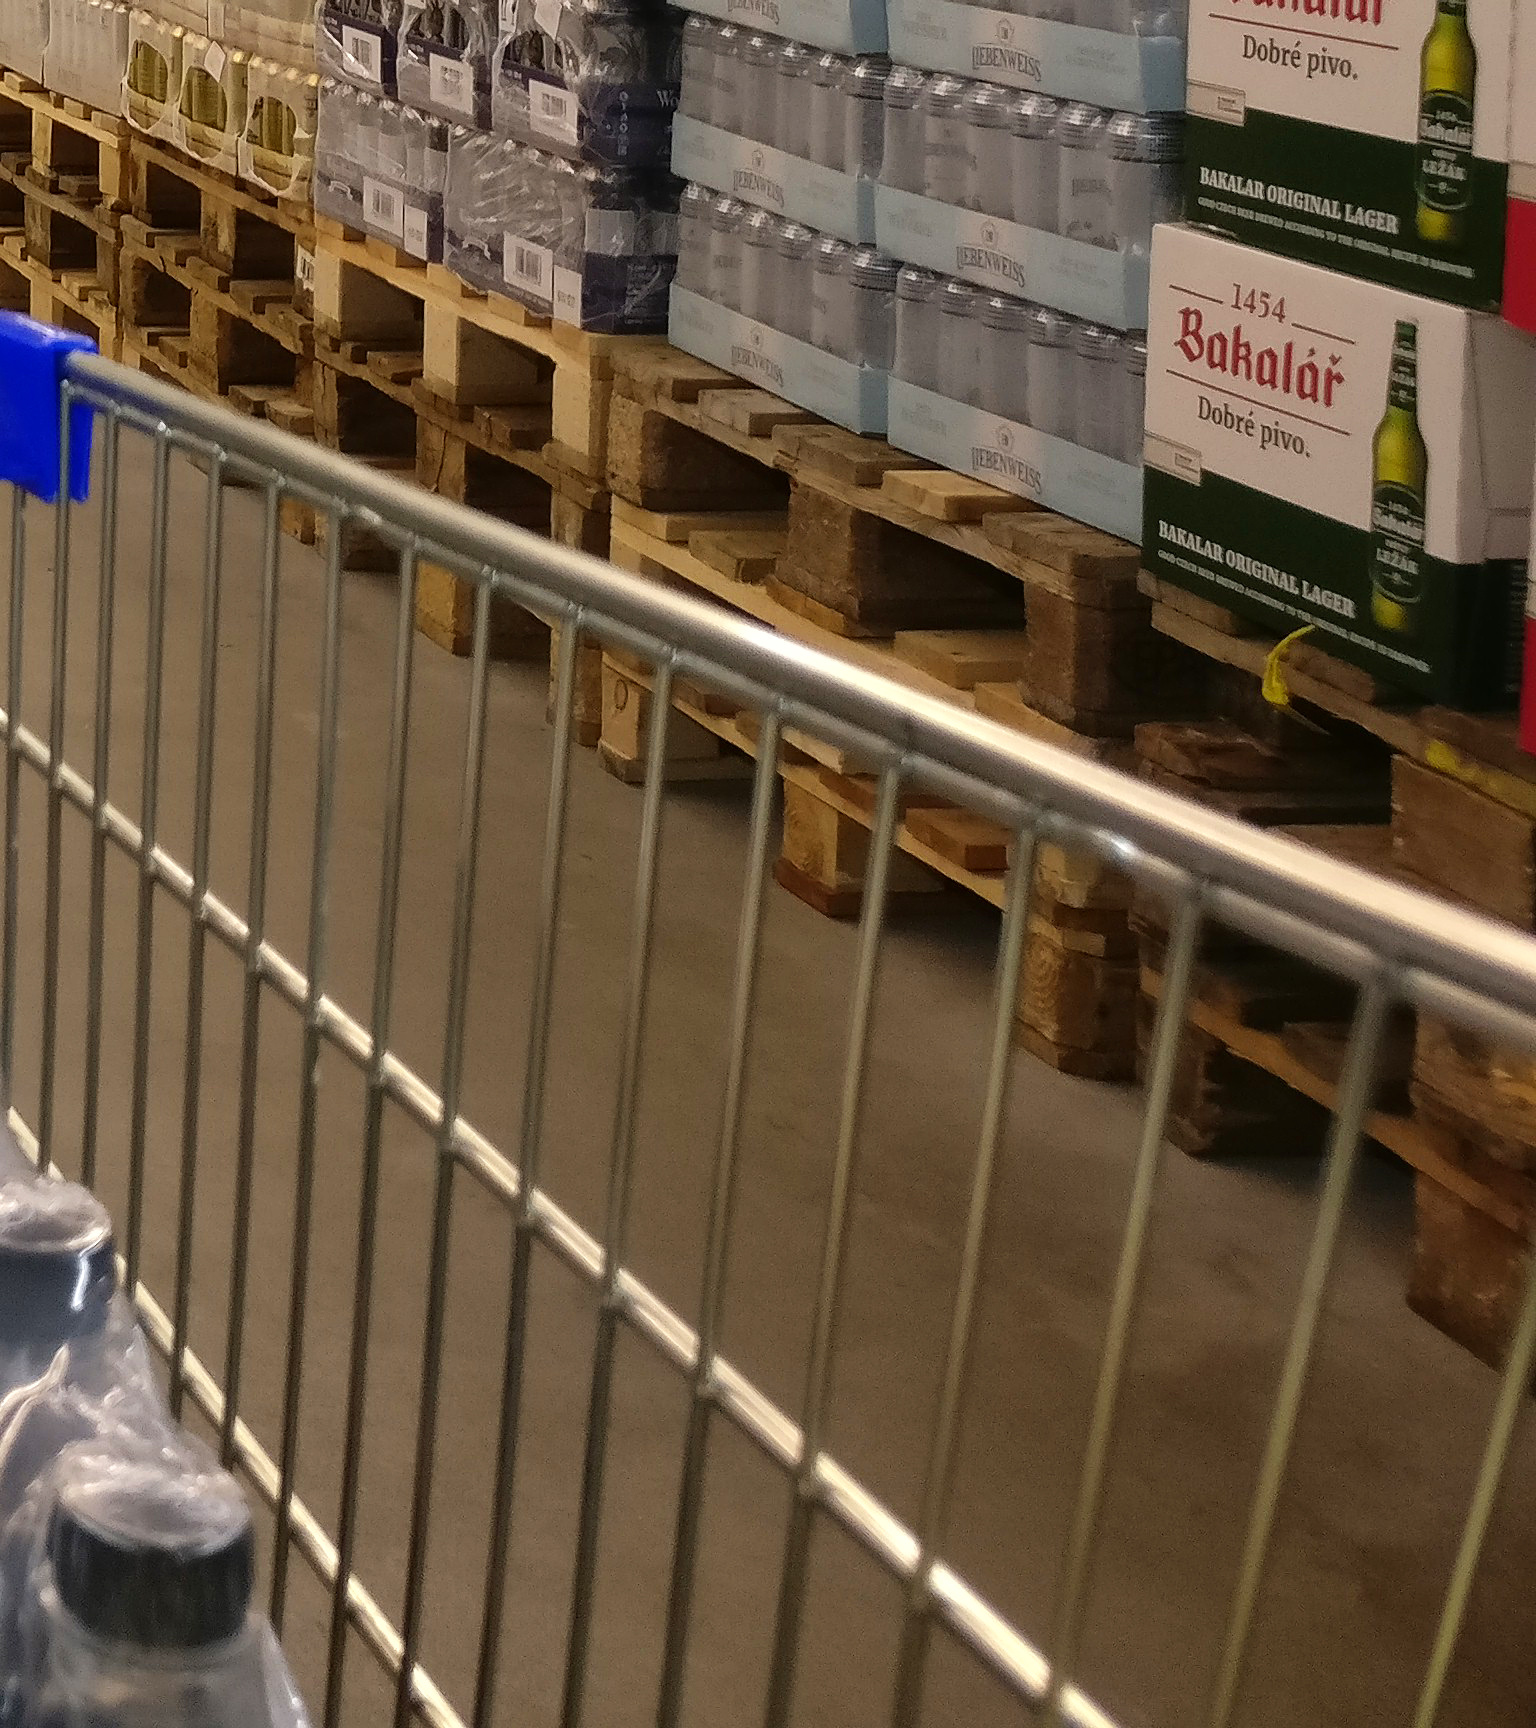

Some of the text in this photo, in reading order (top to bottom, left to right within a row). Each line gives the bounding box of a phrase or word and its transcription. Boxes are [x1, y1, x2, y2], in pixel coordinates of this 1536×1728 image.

[1242, 33, 1358, 80] Dobré pivo.
[1198, 166, 1401, 236] BAKALAR ORIGINAL LAGER
[1229, 282, 1287, 324] 1454
[1172, 306, 1347, 408] Bakalář
[1196, 395, 1312, 460] Dobré pivo.
[1158, 518, 1357, 620] BAKALAR ORIGINAL LAGER
